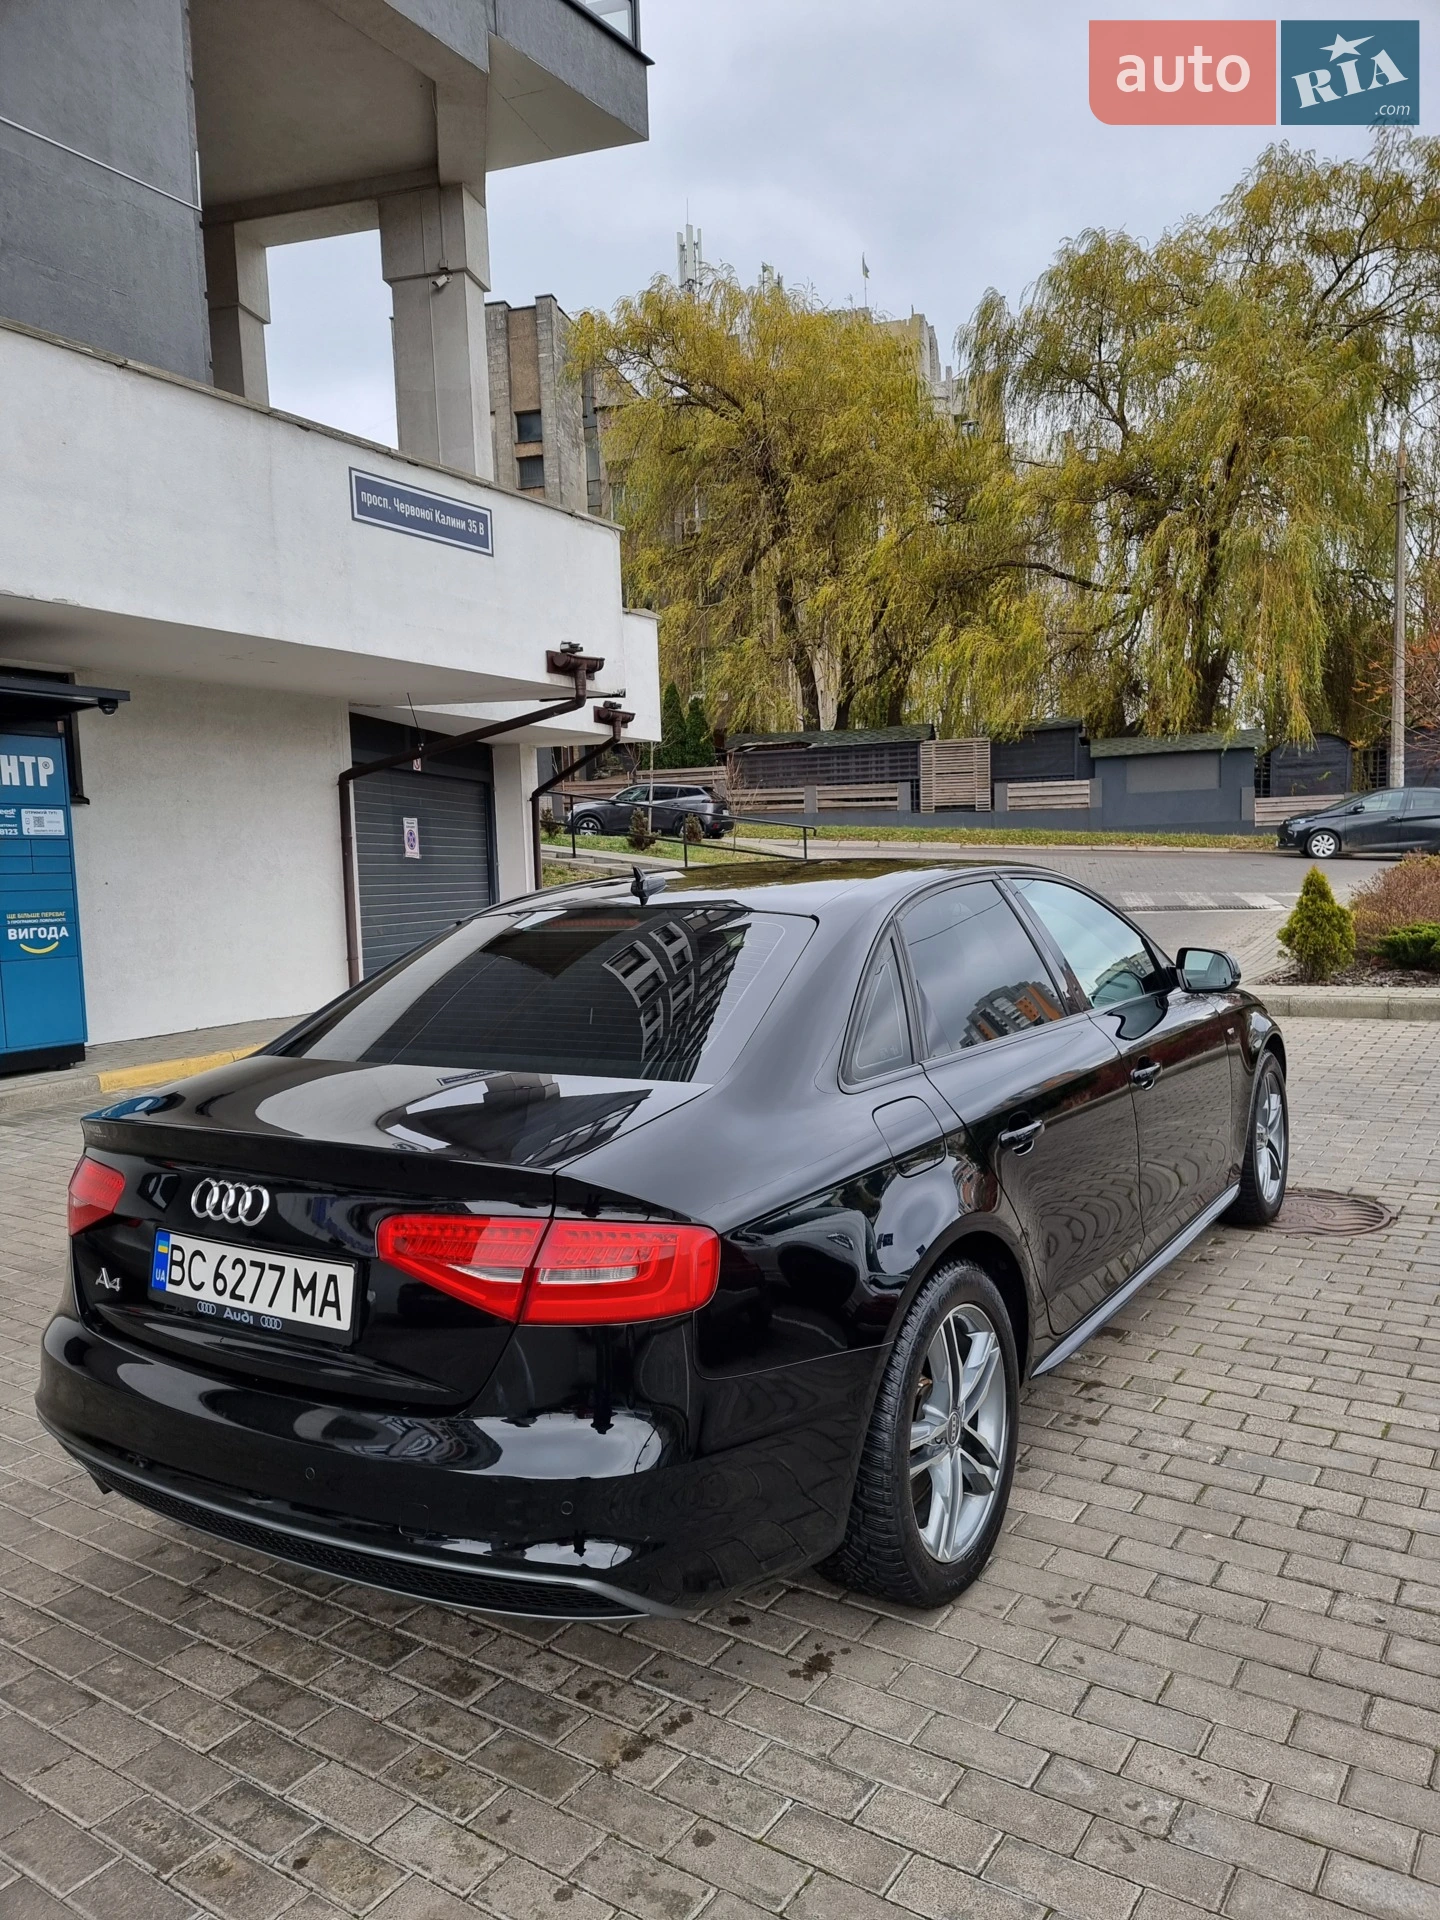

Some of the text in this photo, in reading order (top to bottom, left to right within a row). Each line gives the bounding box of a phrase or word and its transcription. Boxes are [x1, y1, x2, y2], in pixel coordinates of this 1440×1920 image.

[361, 491, 485, 536] просп. Червоної Калини 35 В
[0, 754, 54, 787] НТР
[7, 926, 69, 940] ВИГОДА
[95, 1267, 122, 1292] A4
[155, 1268, 166, 1283] UA
[168, 1244, 342, 1321] BC 6277 MA
[223, 1307, 254, 1325] Audi
